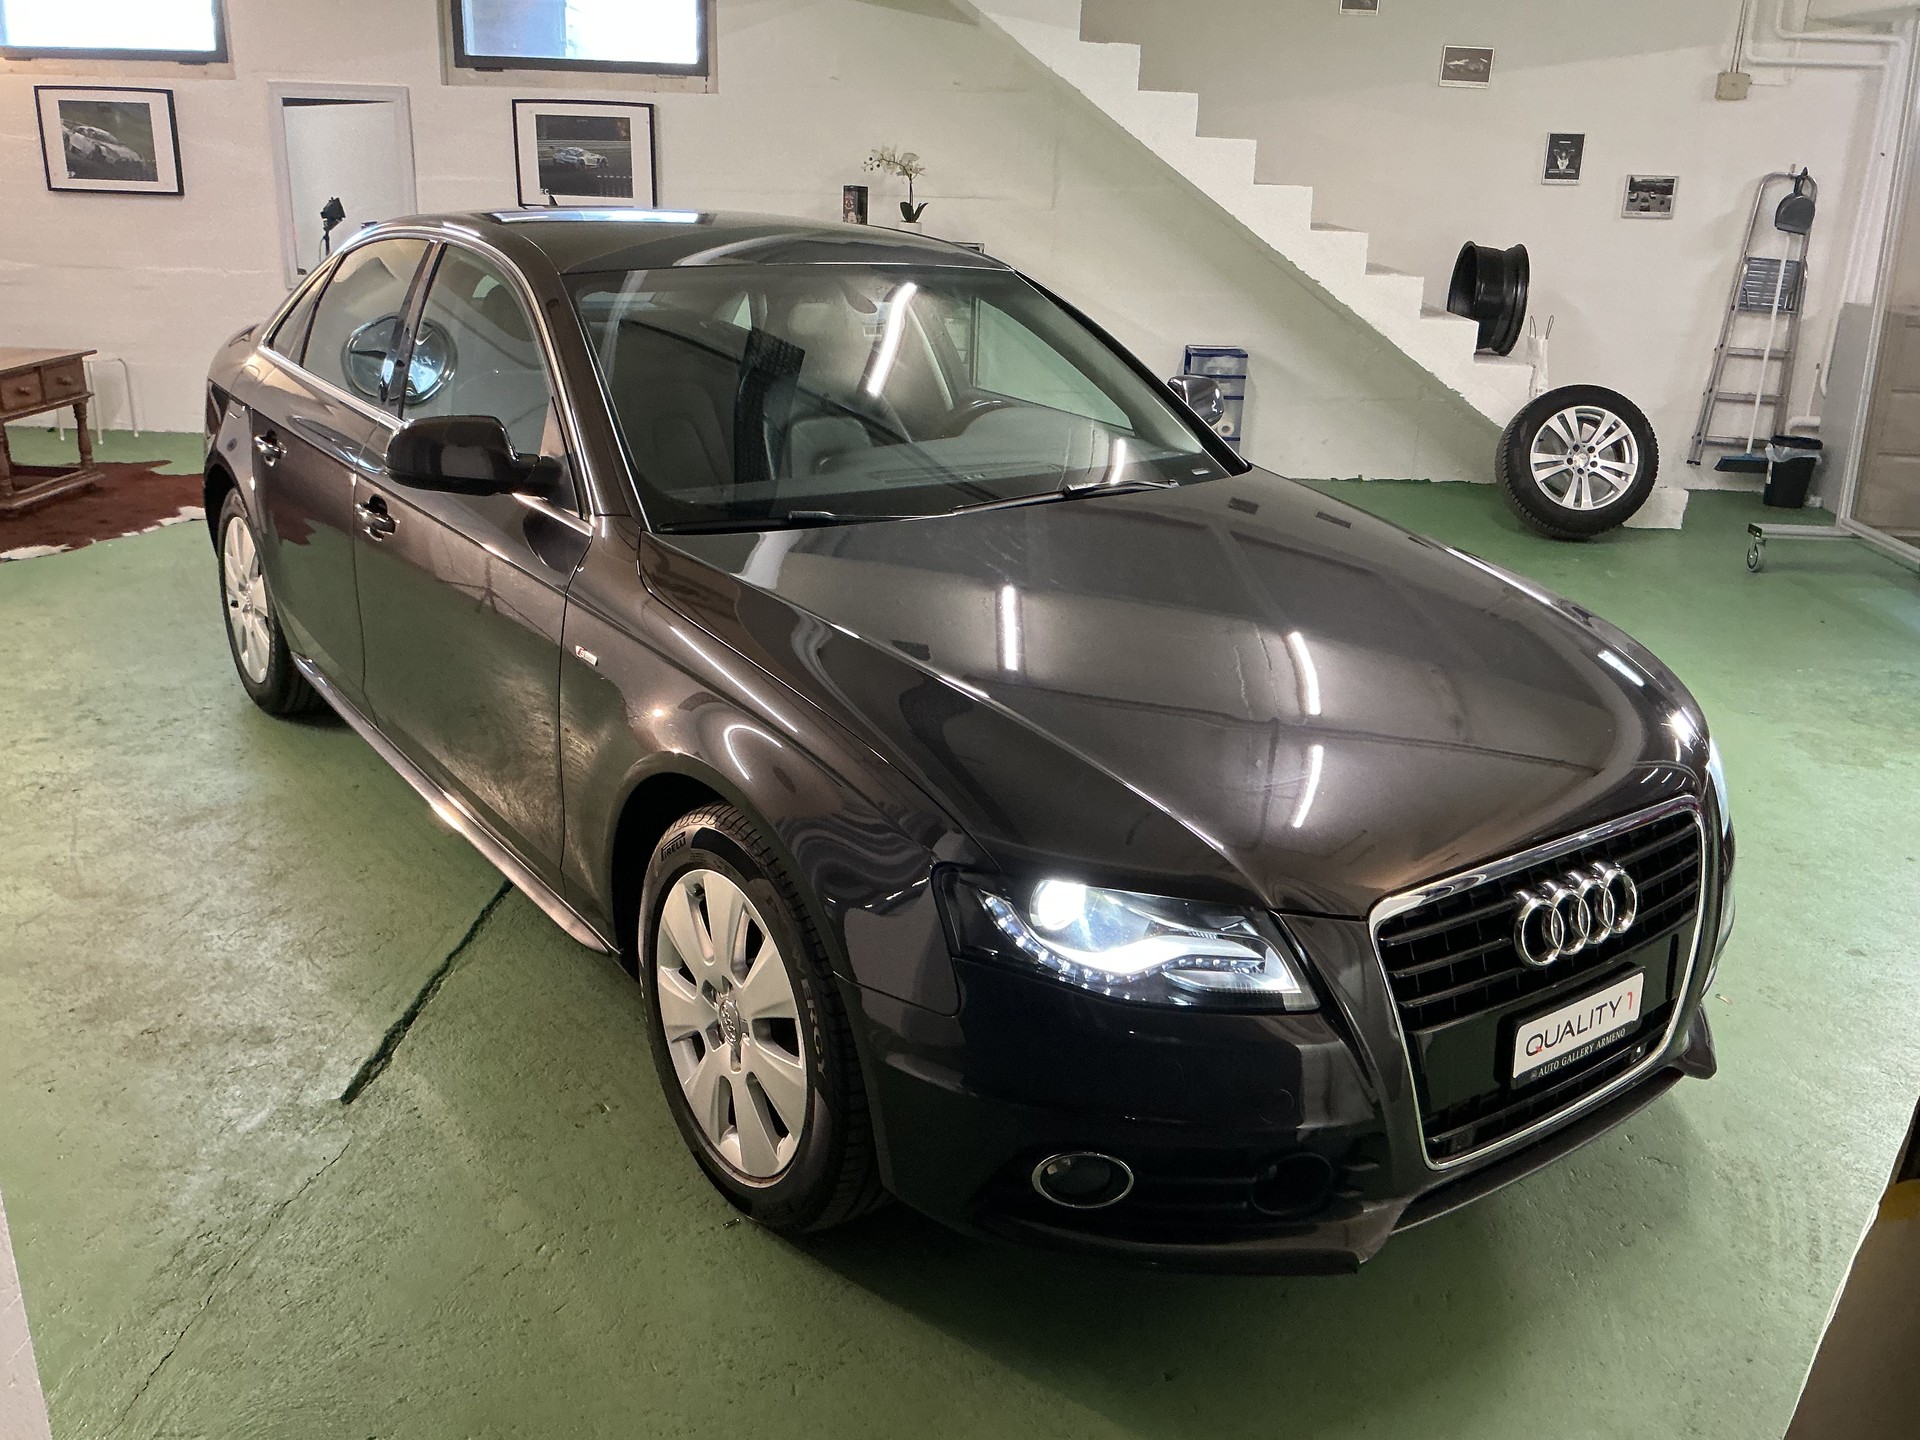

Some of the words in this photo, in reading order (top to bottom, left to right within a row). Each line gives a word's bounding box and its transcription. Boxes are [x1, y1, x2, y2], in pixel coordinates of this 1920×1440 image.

[661, 831, 686, 862] PIRELLI
[1525, 995, 1622, 1057] QUALITY
[1627, 991, 1633, 1010] 1
[1537, 1061, 1559, 1077] AUTO
[1561, 1044, 1594, 1066] GALLERY
[1596, 1028, 1626, 1050] ARMENO
